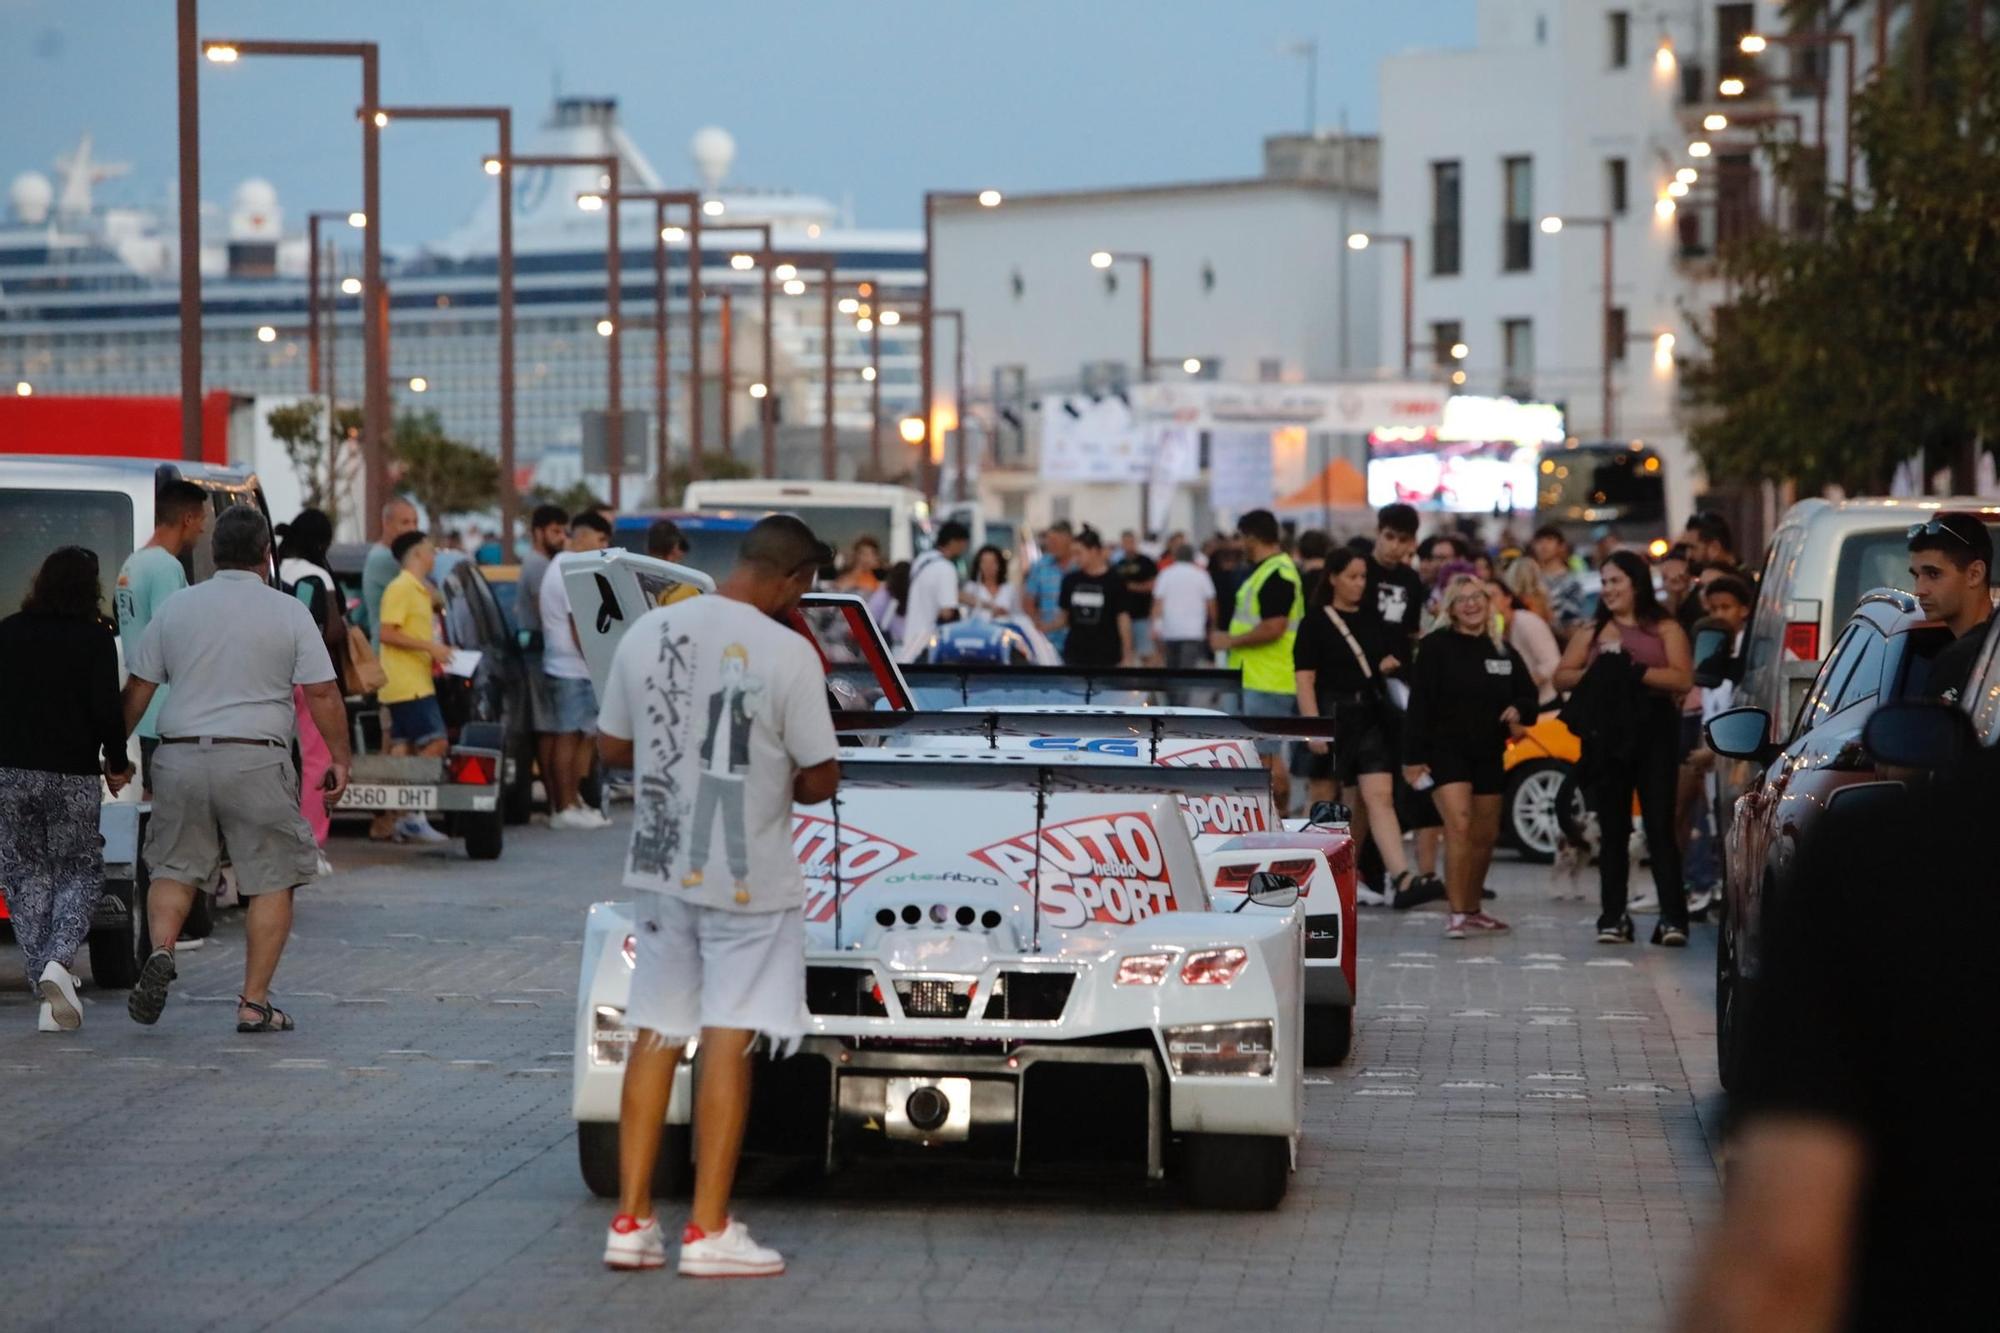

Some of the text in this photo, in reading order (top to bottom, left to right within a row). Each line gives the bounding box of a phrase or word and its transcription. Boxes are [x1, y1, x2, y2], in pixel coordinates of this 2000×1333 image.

[342, 787, 432, 806] 3560 DHT
[984, 815, 1163, 884] AUTO
[1093, 859, 1137, 879] hebdo
[1028, 871, 1173, 928] SPORT
